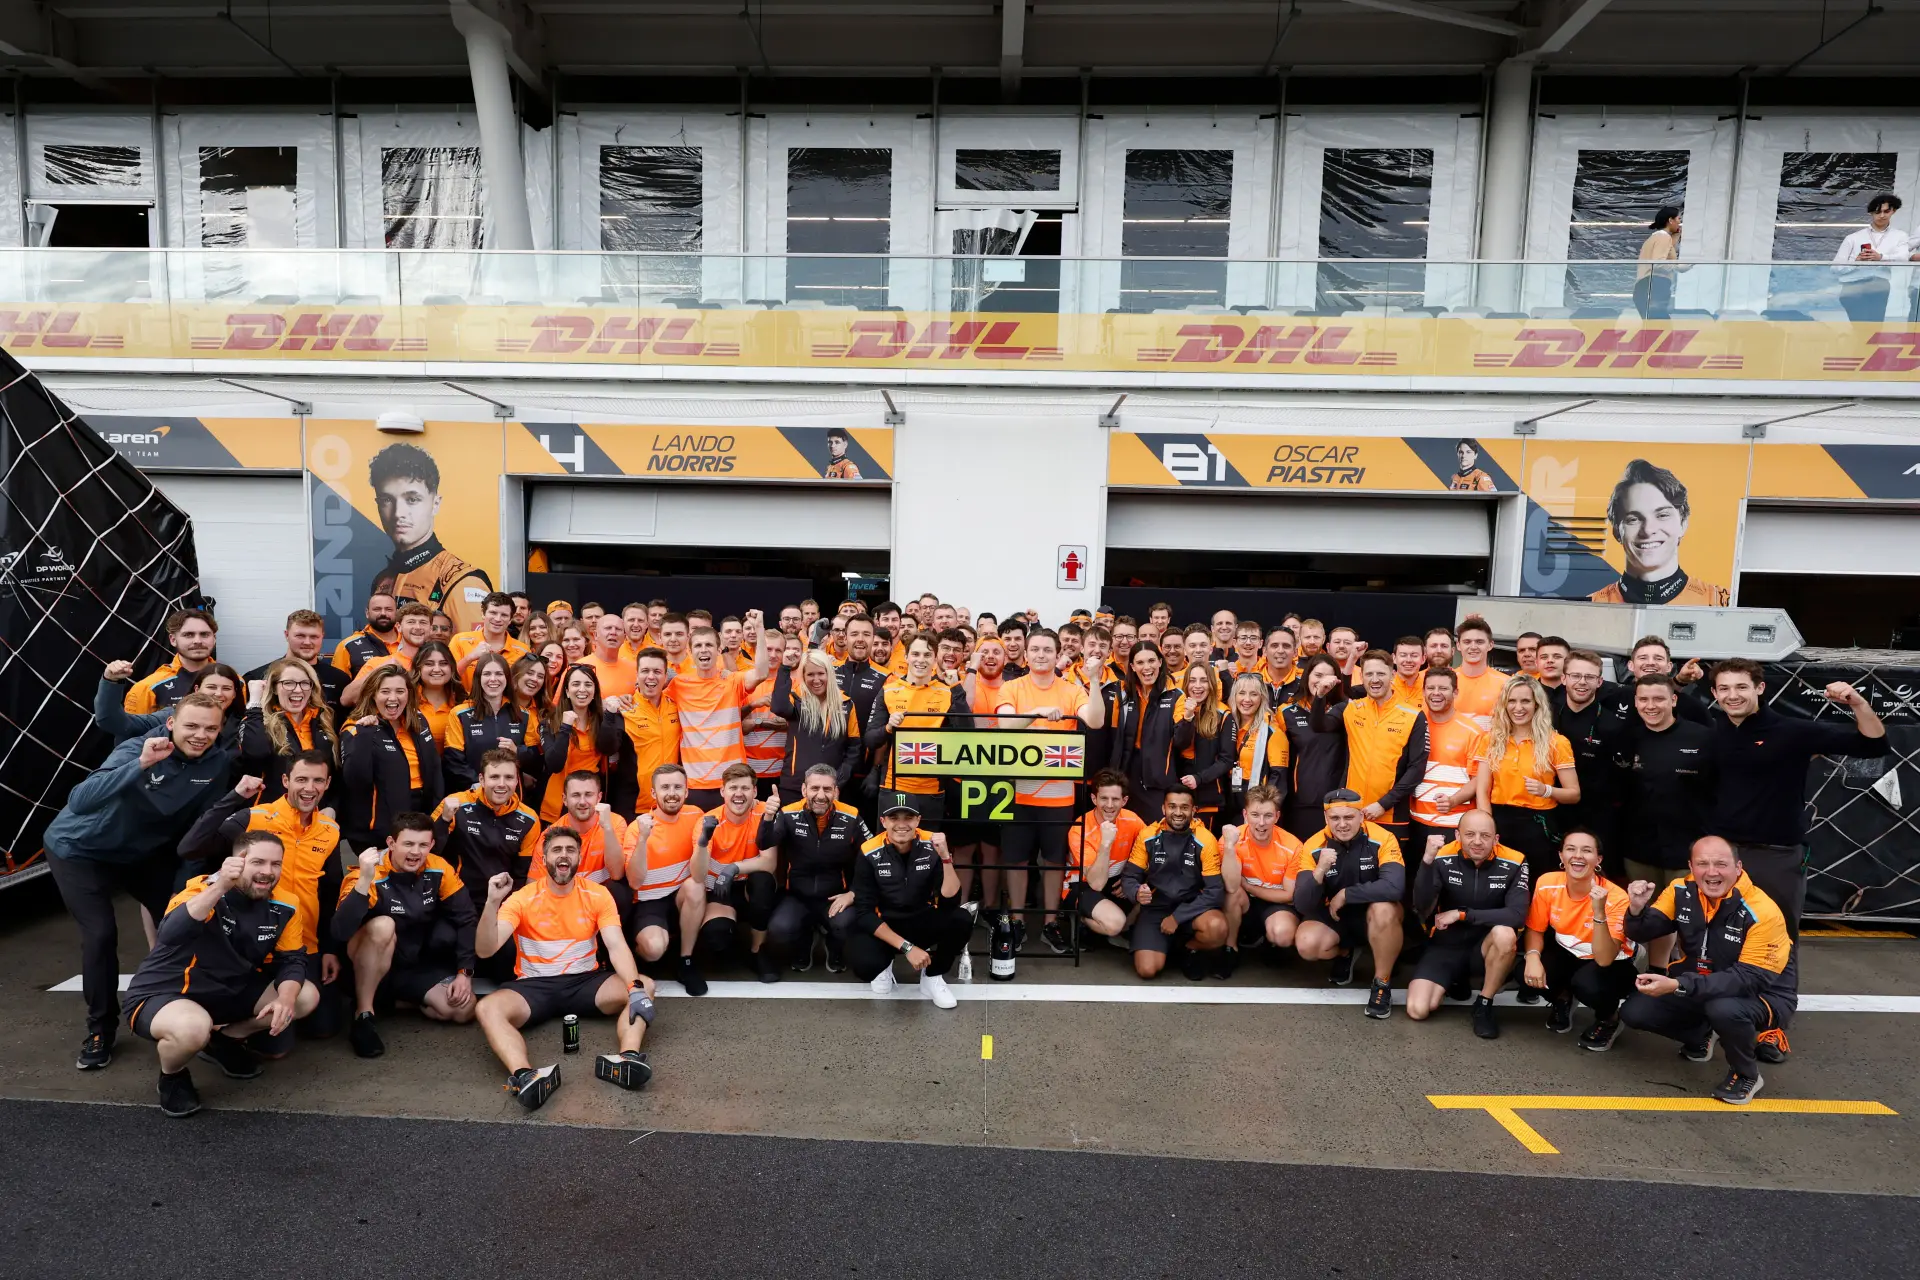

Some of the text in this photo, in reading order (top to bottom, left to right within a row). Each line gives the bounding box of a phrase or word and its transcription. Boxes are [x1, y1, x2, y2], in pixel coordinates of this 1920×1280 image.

[0, 311, 93, 348] HL
[222, 313, 397, 351] DHL
[527, 316, 708, 356] DHL
[845, 320, 1031, 360] DHL
[1171, 324, 1362, 365] DHL
[1505, 328, 1708, 369] DHL
[651, 434, 735, 453] LANDO
[1163, 443, 1227, 482] 81
[1273, 445, 1359, 464] OSCAR
[646, 454, 737, 473] NORRIS
[1266, 465, 1366, 484] PIASTRI
[1522, 455, 1579, 597] CAR
[936, 744, 1043, 766] LANDO
[960, 780, 1015, 820] P2
